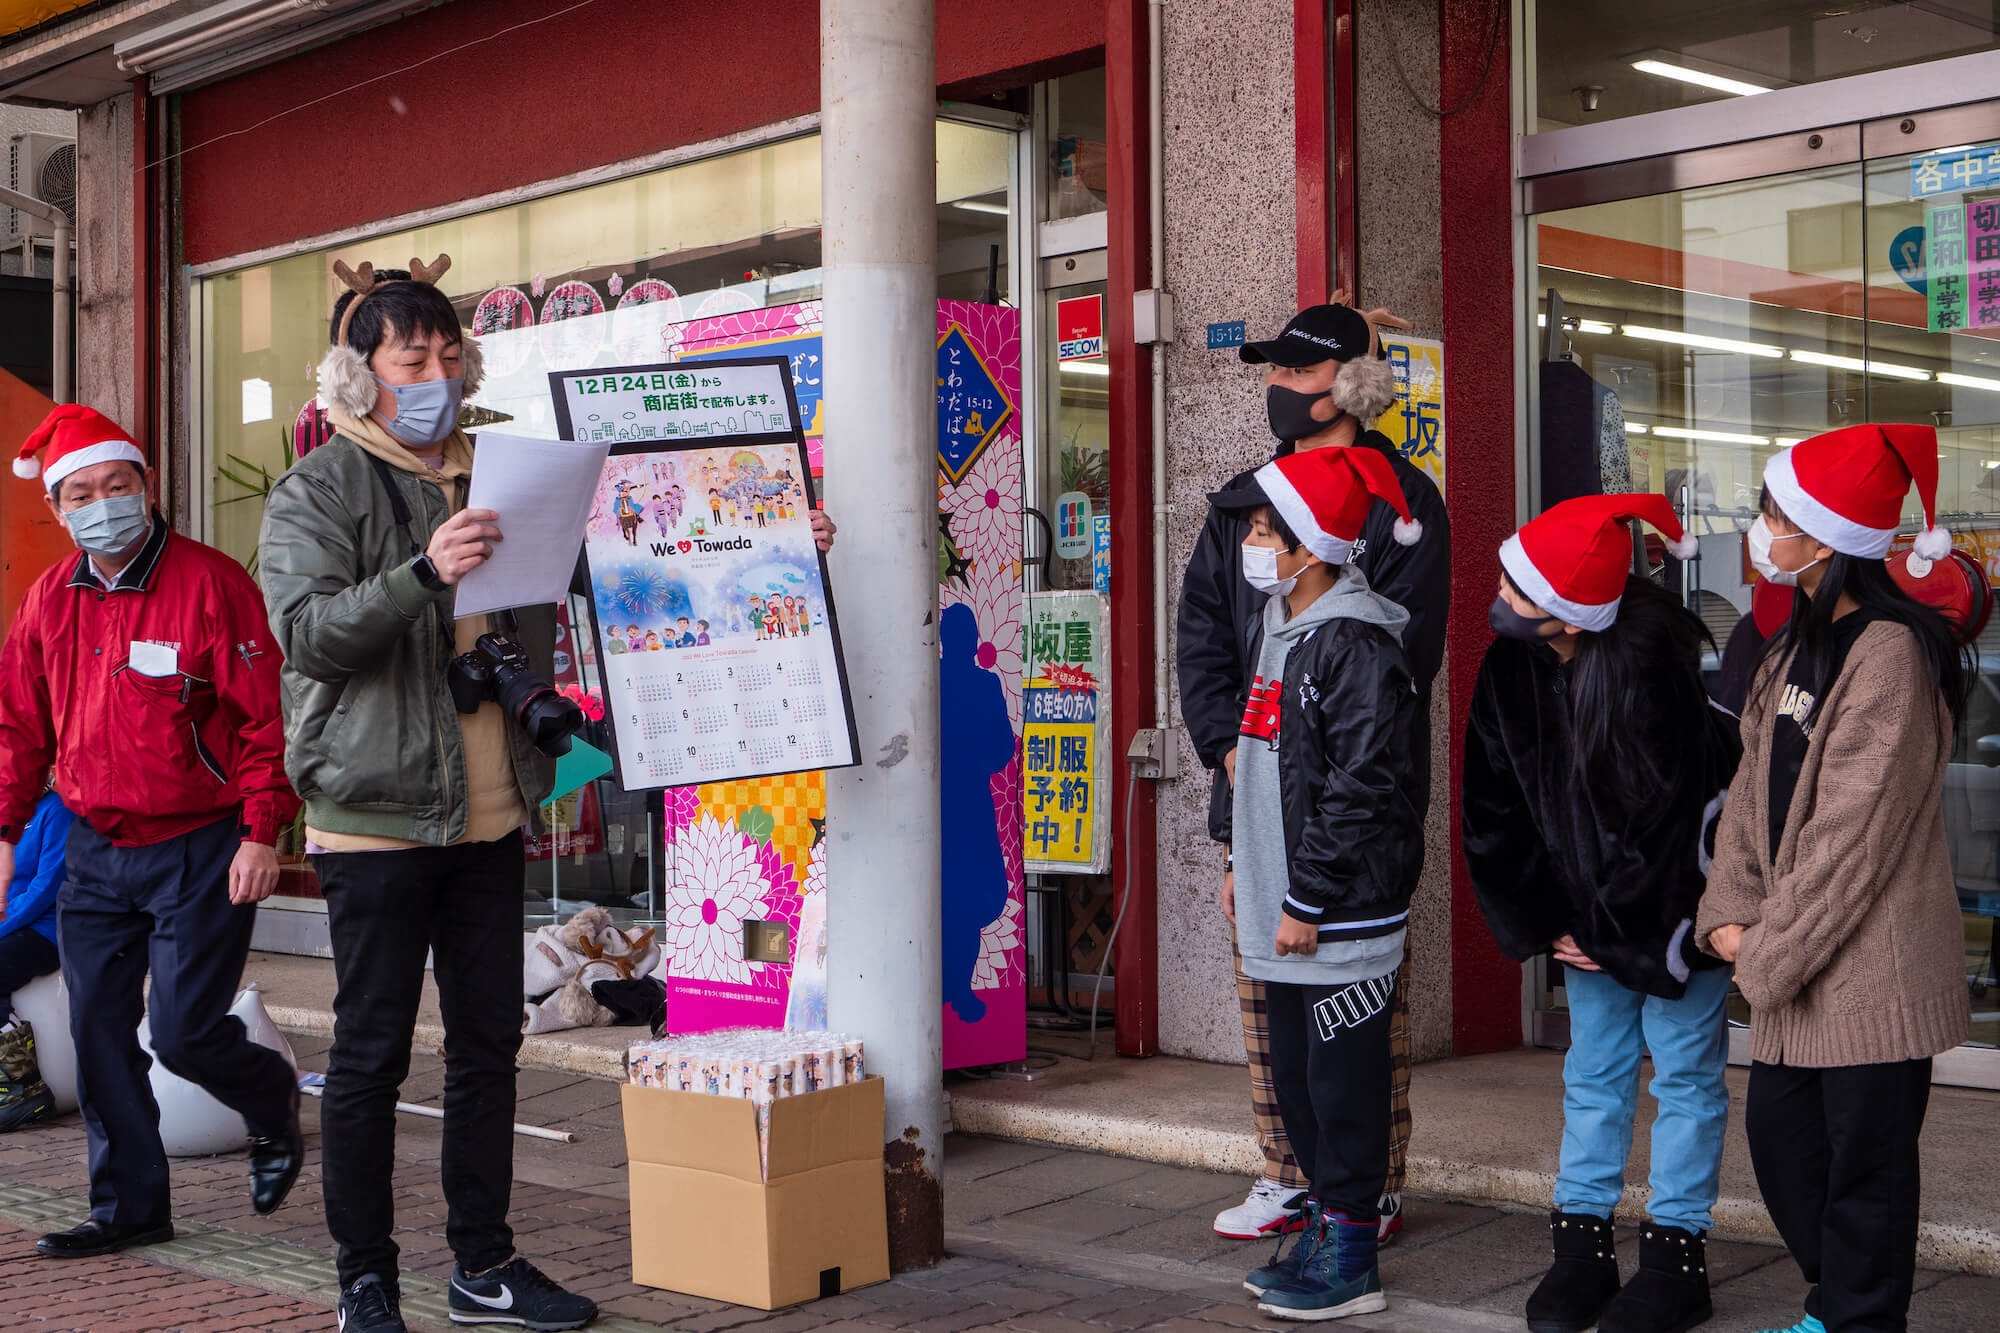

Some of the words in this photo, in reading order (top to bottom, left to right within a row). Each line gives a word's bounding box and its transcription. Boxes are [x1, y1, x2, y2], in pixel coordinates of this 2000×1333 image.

[1933, 208, 1963, 329] 四和中学校
[1060, 339, 1100, 358] SECOM
[1310, 336, 1342, 349] maker
[643, 391, 776, 412] 商店街で配布します。
[947, 347, 963, 459] とわだばこ
[966, 396, 993, 410] 15-12
[650, 542, 677, 557] We
[693, 535, 753, 553] Towada
[626, 678, 631, 687] 1
[676, 673, 682, 682] 2
[727, 667, 733, 676] 3
[776, 662, 782, 671] 4
[632, 715, 638, 724] 5
[682, 709, 689, 719] 6
[733, 704, 739, 713] 7
[782, 698, 788, 708] 8
[637, 752, 644, 762] 9
[686, 746, 697, 756] 10
[738, 740, 747, 750] 11
[786, 734, 797, 744] 12
[1026, 734, 1089, 773] 制服
[1027, 775, 1089, 814] 予約
[1024, 815, 1083, 854] 中!
